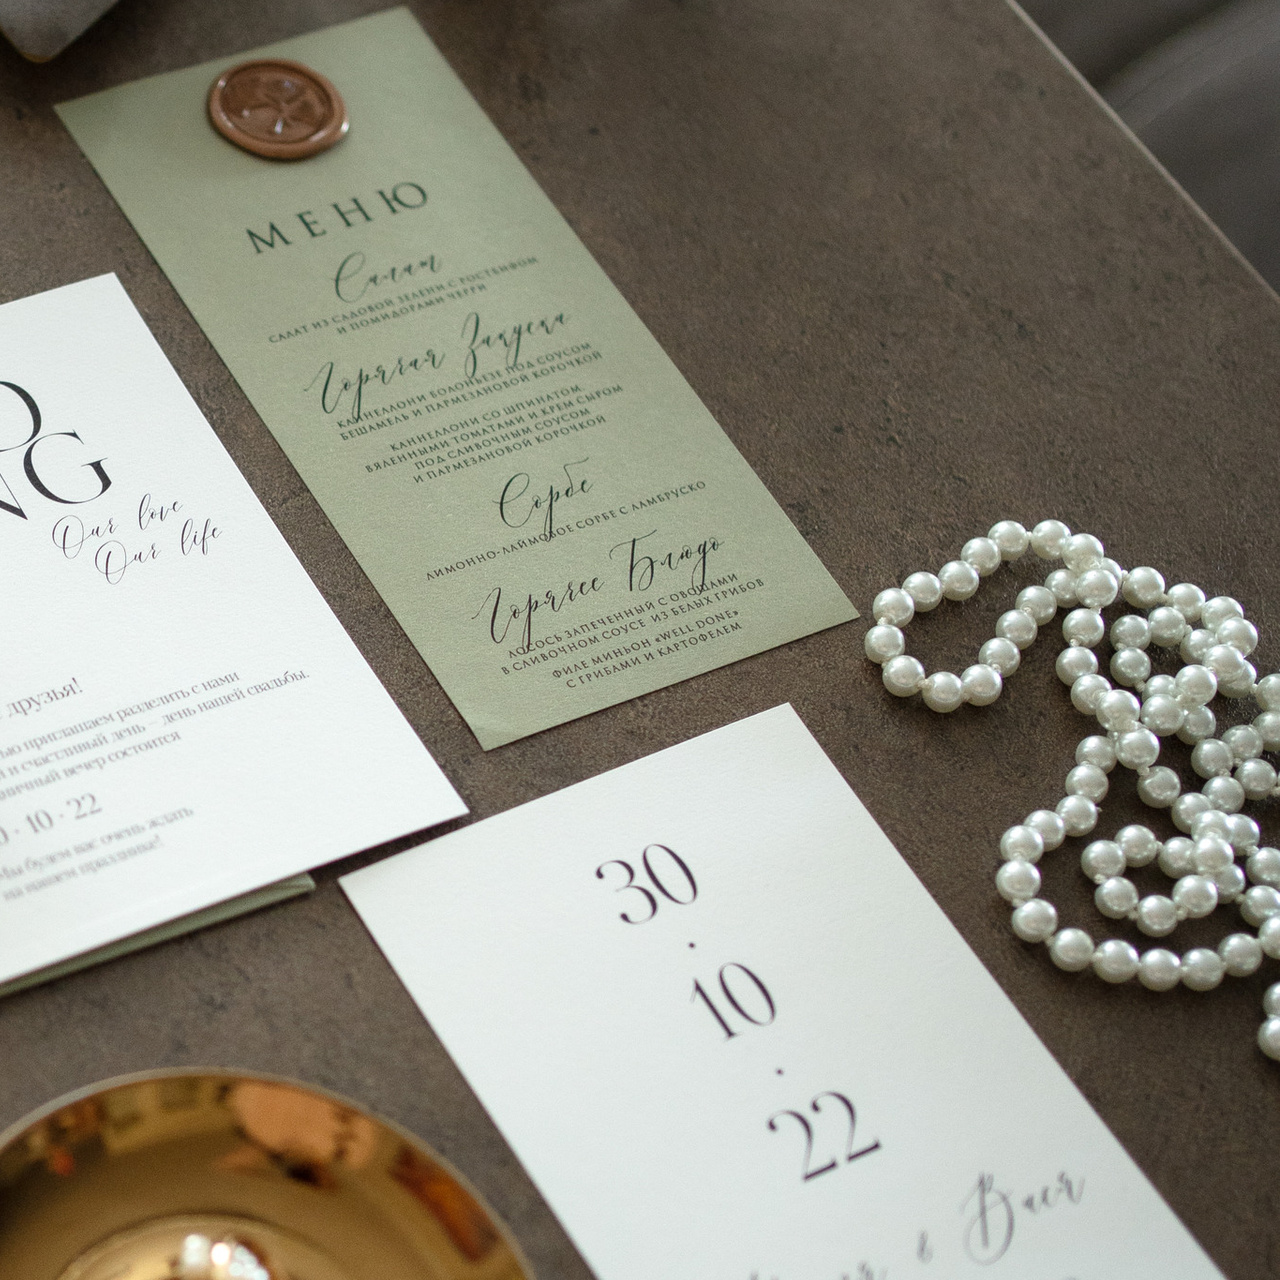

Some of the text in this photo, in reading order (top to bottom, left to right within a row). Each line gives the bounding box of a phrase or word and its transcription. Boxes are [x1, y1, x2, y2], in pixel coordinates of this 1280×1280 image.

[246, 181, 427, 254] МЕНЮ
[269, 255, 539, 343] САЛАТ ИЗ САДОВОЙ ЗЕЛЕНИ С РОСТБИФОМ
[336, 283, 488, 335] И ПОМИДОРАМИ ЧЕРРИ
[336, 342, 593, 429] КАННЕЛЛОНИ БОЛОНЬЕЗЕ ПОД СОУСОМ
[340, 350, 603, 441] БЕШАМЕЛЬ И ПАРМЕЗАНОВОЙ КОРОЧКОЙ
[365, 384, 624, 473] ВЯЛЕННЫМИ ТОМАТАМИ И КРЕМ СЫРОМ
[390, 418, 480, 452] КАННЕЛЛОНИ
[482, 409, 501, 421] СО
[413, 415, 606, 483] И ПАРМЕЗАНОВОЙ КОРОЧКОЙ
[414, 407, 590, 470] ПОД СЛИВОЧНЫМ СОУСОМ
[52, 493, 183, 559] Our love
[426, 481, 706, 581] ЛИМОННО-ЛАЙМОВОЕ СОРБЕ С ЛАМБРУСКО
[492, 458, 594, 542] Сорбе
[94, 518, 223, 585] Our life
[472, 529, 724, 654] Горячее Блюдо
[501, 578, 765, 675] В СЛИВОЧНОМ СОУСЕ ИЗ БЕЛЫХ ГРИБОВ
[508, 573, 738, 659] ЛОСОСЬ ЗАПЕЧЕННЫЙ С ОВОЩАМИ
[552, 609, 740, 680] ФИЛЕ МИНЬОН «WELL DONE»
[566, 622, 743, 688] С ГРИБАМИ И КАРТОФЕЛЕМ
[5, 676, 84, 718] друзья!
[9, 765, 20, 780] и
[21, 731, 109, 773] счастливый
[110, 723, 146, 747] день
[161, 705, 196, 729] день
[198, 687, 246, 712] нашей
[246, 669, 310, 697] свадьбы.
[23, 712, 115, 754] приглашаем
[117, 687, 191, 722] разделить
[191, 683, 201, 694] с
[202, 671, 240, 692] нами
[63, 752, 106, 780] вечер
[107, 730, 182, 763] состоится
[25, 808, 54, 836] 10
[66, 793, 102, 822] 22
[595, 843, 698, 924] 30
[690, 962, 776, 1040] 10
[767, 1091, 881, 1182] 22
